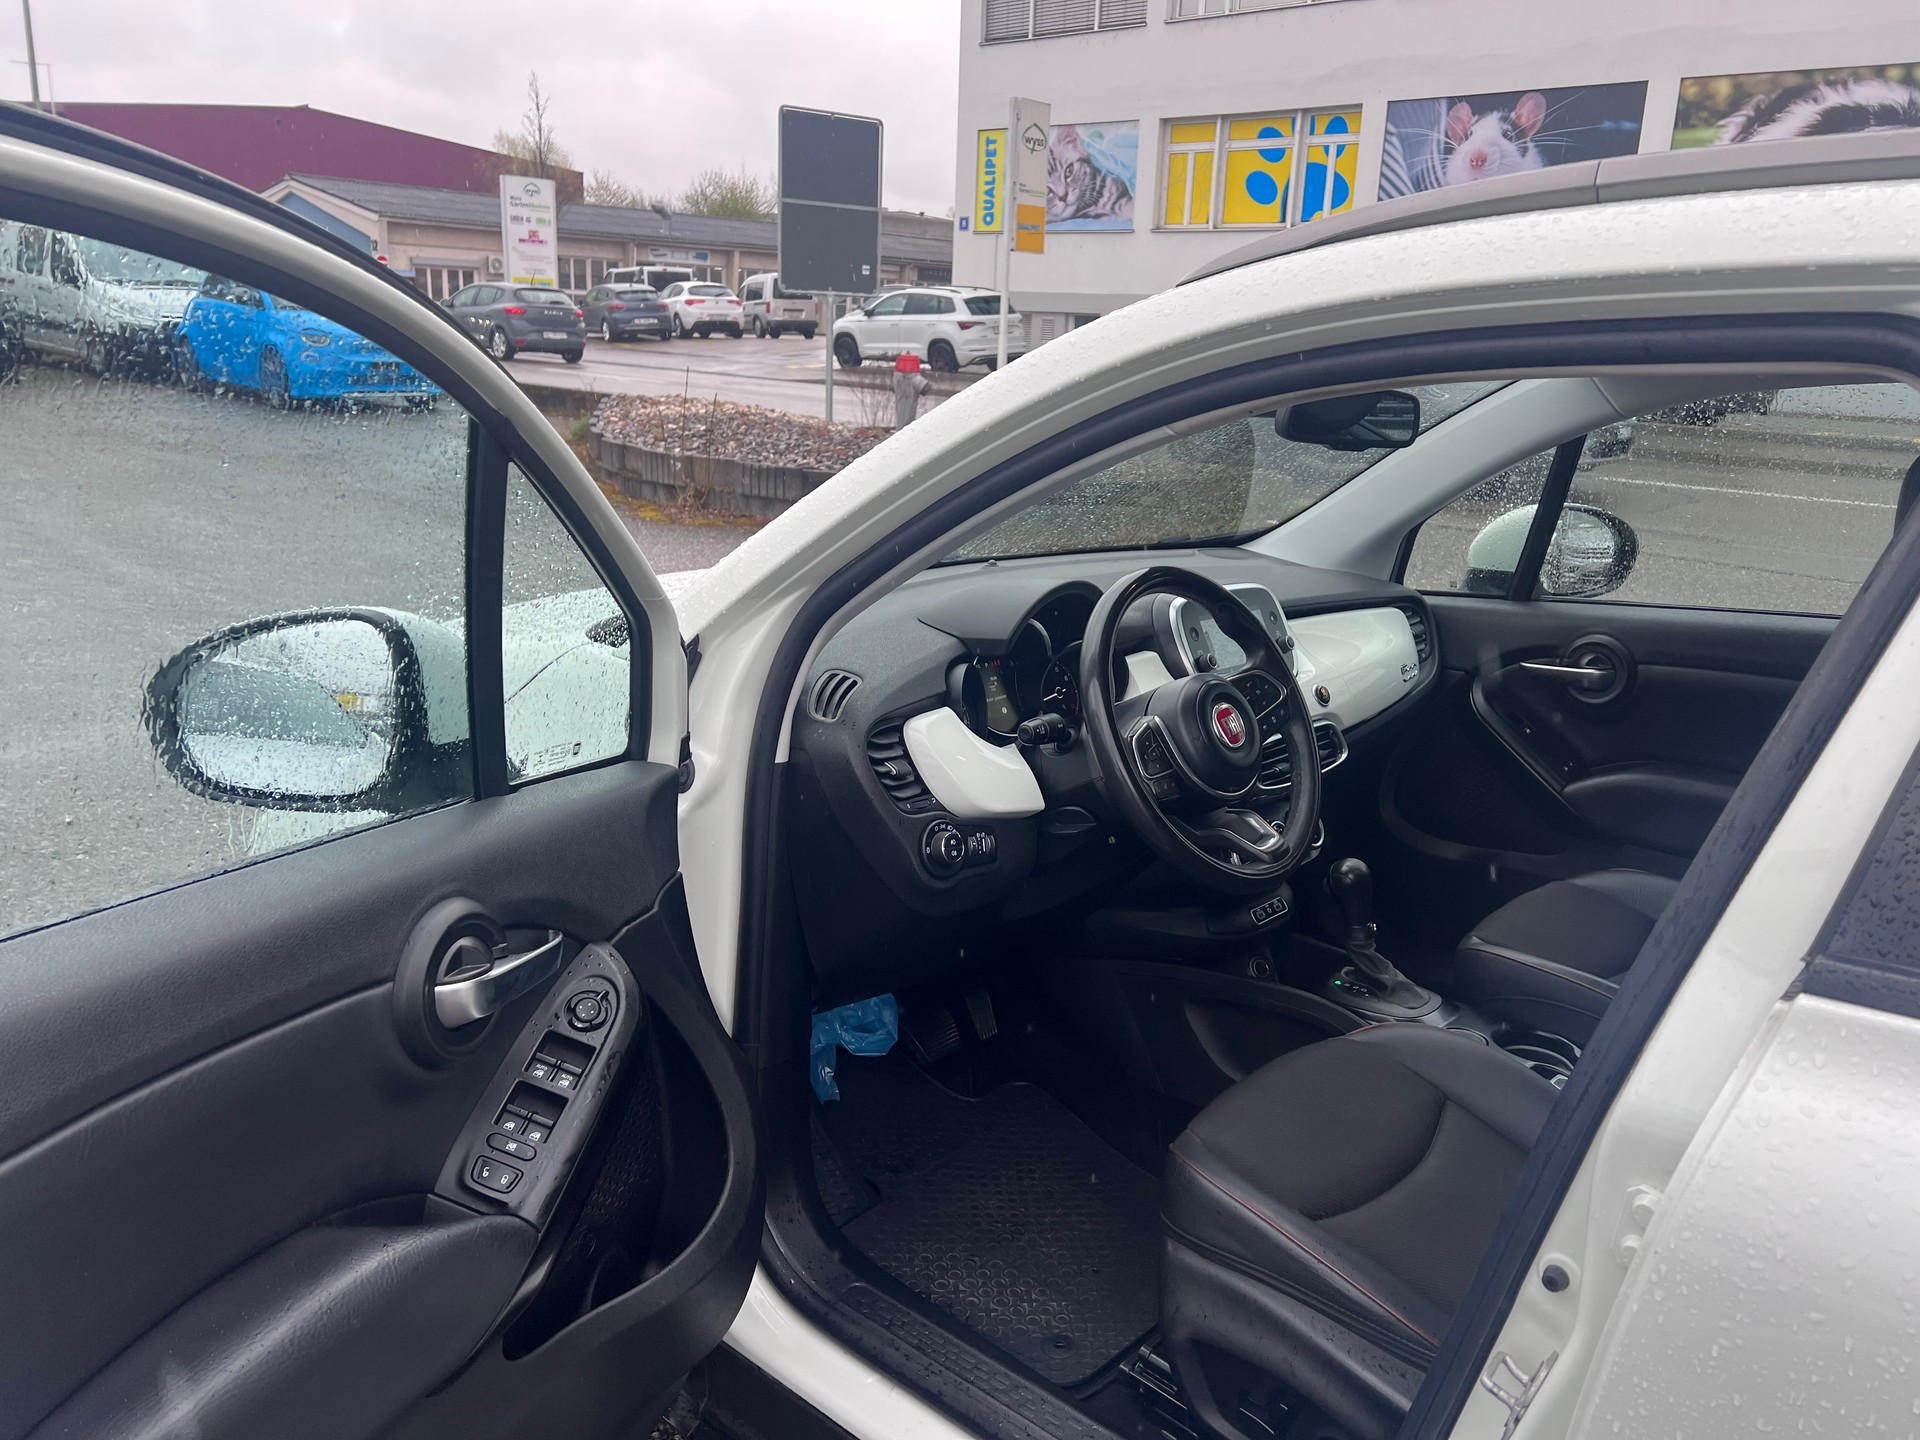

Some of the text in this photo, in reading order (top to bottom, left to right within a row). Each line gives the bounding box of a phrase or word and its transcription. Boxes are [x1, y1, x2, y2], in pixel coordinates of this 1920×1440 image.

[1024, 136, 1044, 154] wyss
[983, 136, 997, 226] QUALIPET
[1221, 712, 1241, 738] FIAT
[561, 1073, 573, 1081] AUTO
